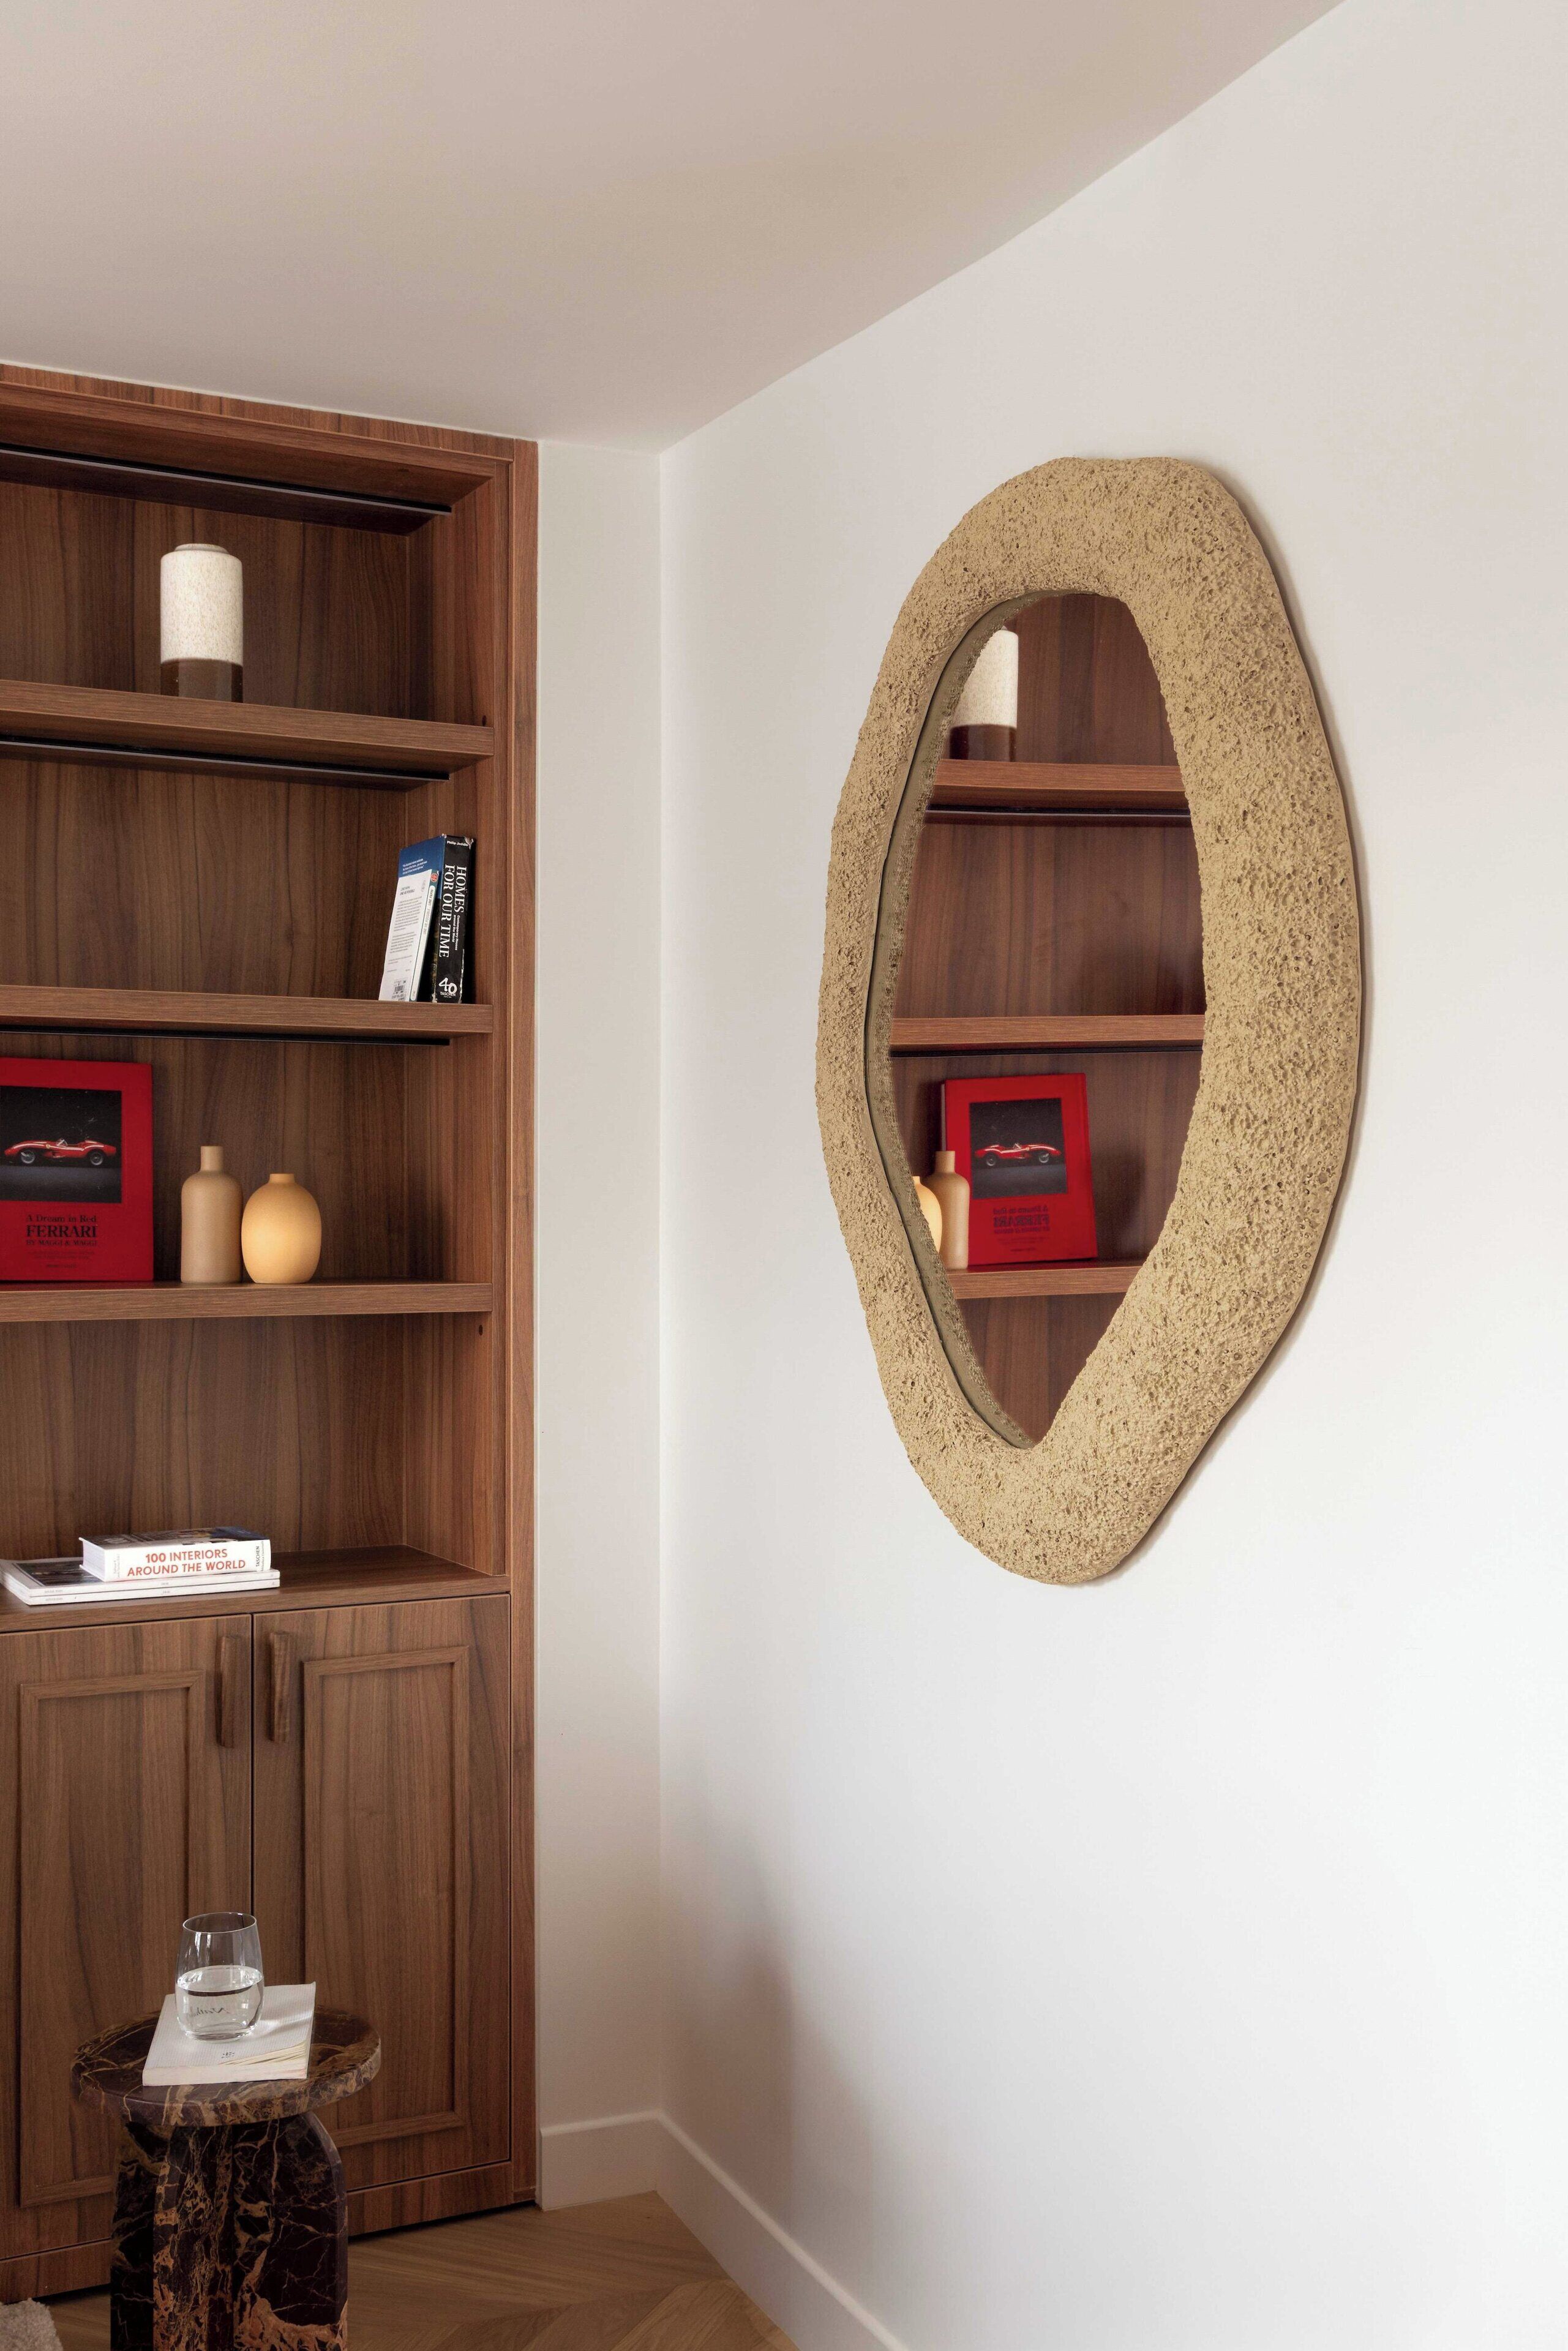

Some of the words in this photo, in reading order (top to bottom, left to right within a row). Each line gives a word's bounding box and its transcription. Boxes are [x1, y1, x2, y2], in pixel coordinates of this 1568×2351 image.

[443, 864, 456, 890] FOR
[454, 866, 467, 913] HOMES
[441, 893, 453, 921] OUR
[438, 924, 451, 958] TIME
[438, 977, 458, 995] 40
[26, 1225, 97, 1237] FERRARI
[146, 1553, 167, 1563] 100
[170, 1549, 227, 1561] INTERIORS
[127, 1564, 178, 1577] AROUND
[182, 1563, 201, 1572] THE
[206, 1560, 246, 1570] WORLD
